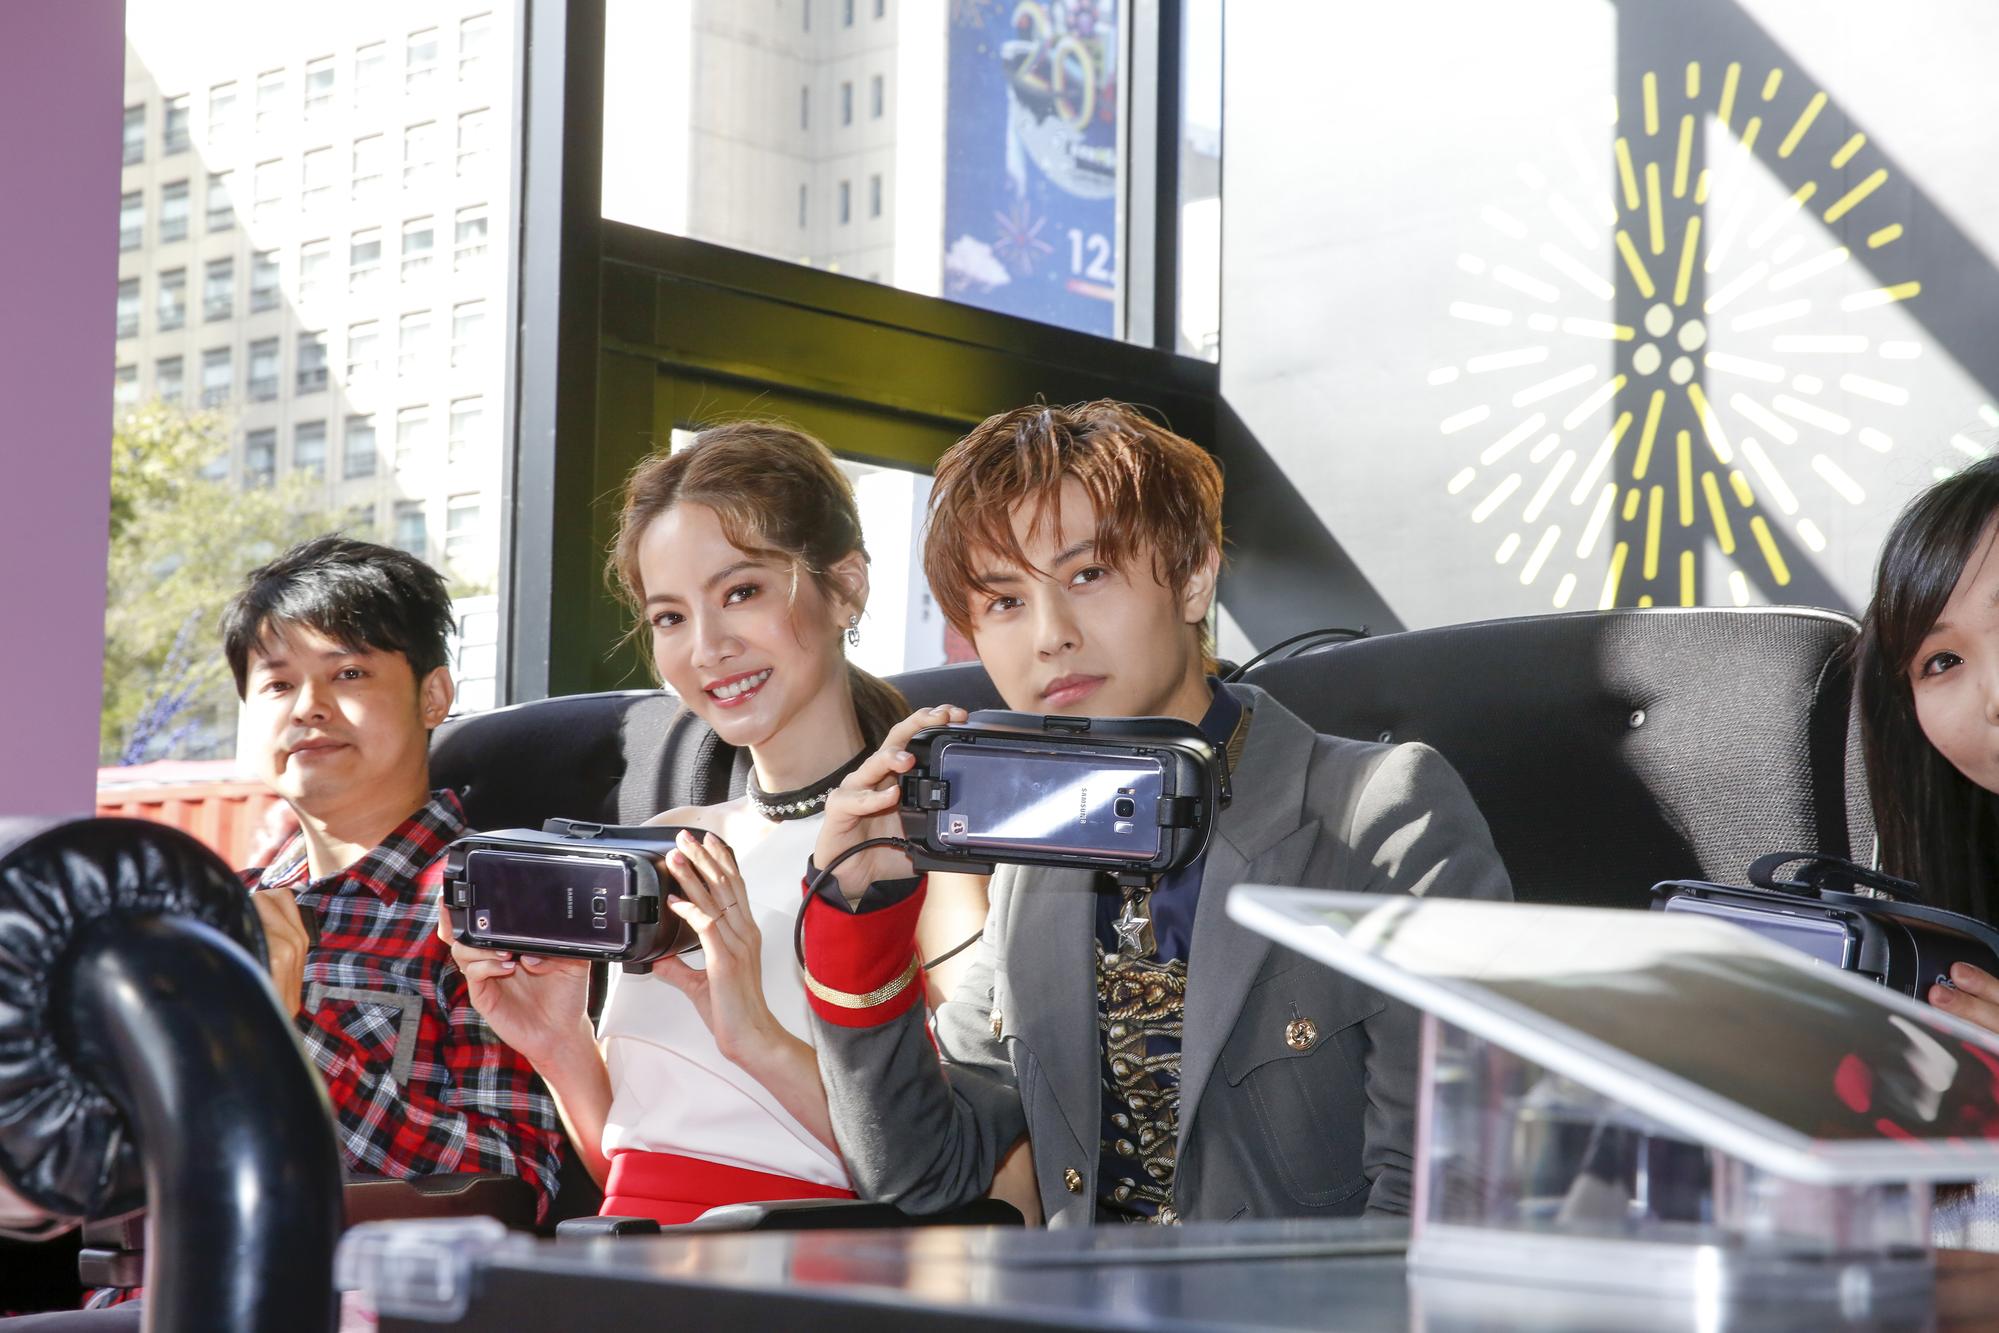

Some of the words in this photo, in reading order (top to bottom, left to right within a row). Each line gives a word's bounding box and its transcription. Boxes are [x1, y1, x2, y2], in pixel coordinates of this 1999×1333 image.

[1067, 228, 1115, 281] 12
[1079, 787, 1088, 824] SAMSUNG
[566, 887, 574, 919] SAMSUNG
